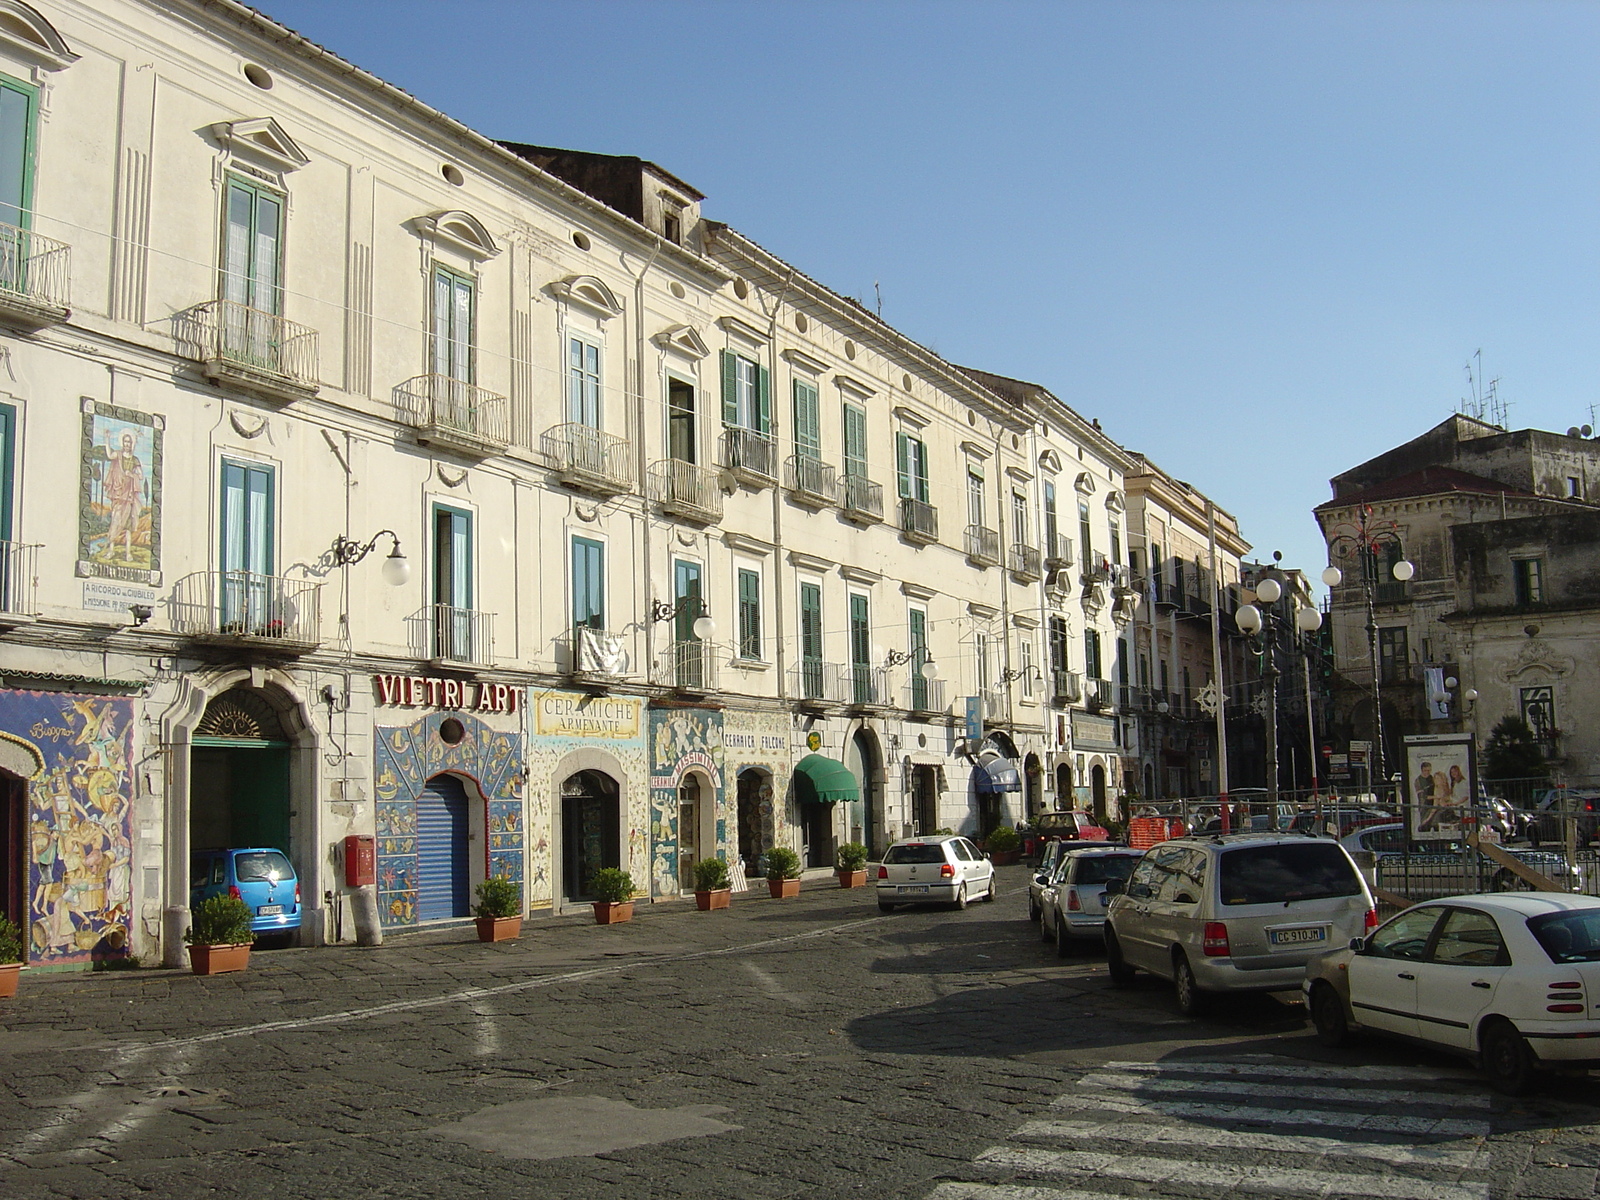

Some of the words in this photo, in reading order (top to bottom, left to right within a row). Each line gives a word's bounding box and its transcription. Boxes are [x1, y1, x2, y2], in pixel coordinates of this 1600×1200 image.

[92, 584, 121, 596] RICORDO
[127, 589, 155, 600] GIUBILEO
[378, 674, 467, 708] VIETRI
[479, 682, 524, 712] ART
[545, 698, 633, 720] CERAMICHE
[560, 717, 619, 732] ARMENANTE
[675, 751, 718, 778] MASSIMINO
